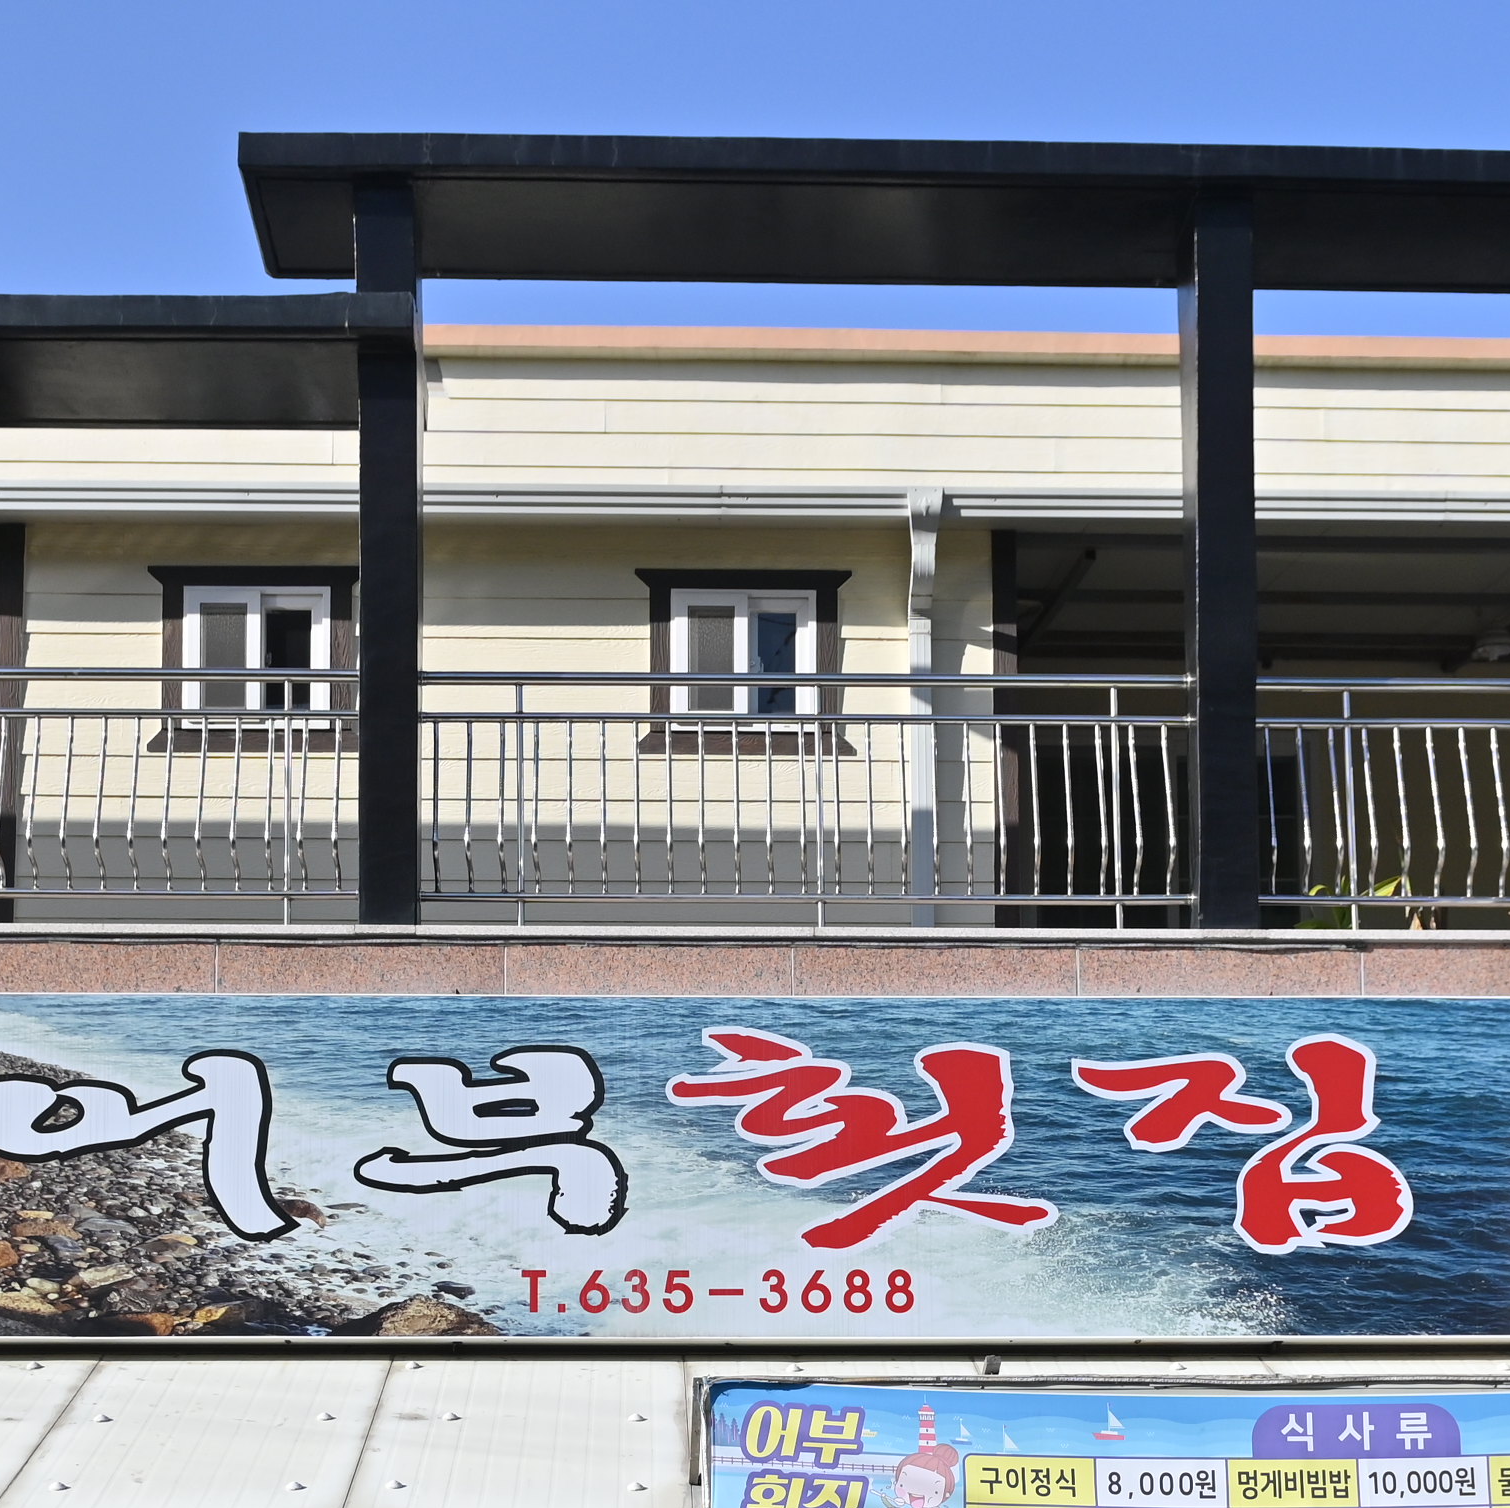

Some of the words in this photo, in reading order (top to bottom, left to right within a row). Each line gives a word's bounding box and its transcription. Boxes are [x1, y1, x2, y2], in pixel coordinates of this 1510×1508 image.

[522, 1268, 916, 1313] T.635-3688
[739, 1400, 865, 1466] 어부
[1281, 1412, 1433, 1451] 식사류
[980, 1466, 1077, 1498] 구이정식
[1108, 1469, 1218, 1501] 8,000원
[1237, 1468, 1351, 1501] 멍게비빔밥
[1368, 1467, 1477, 1498] 10,000원
